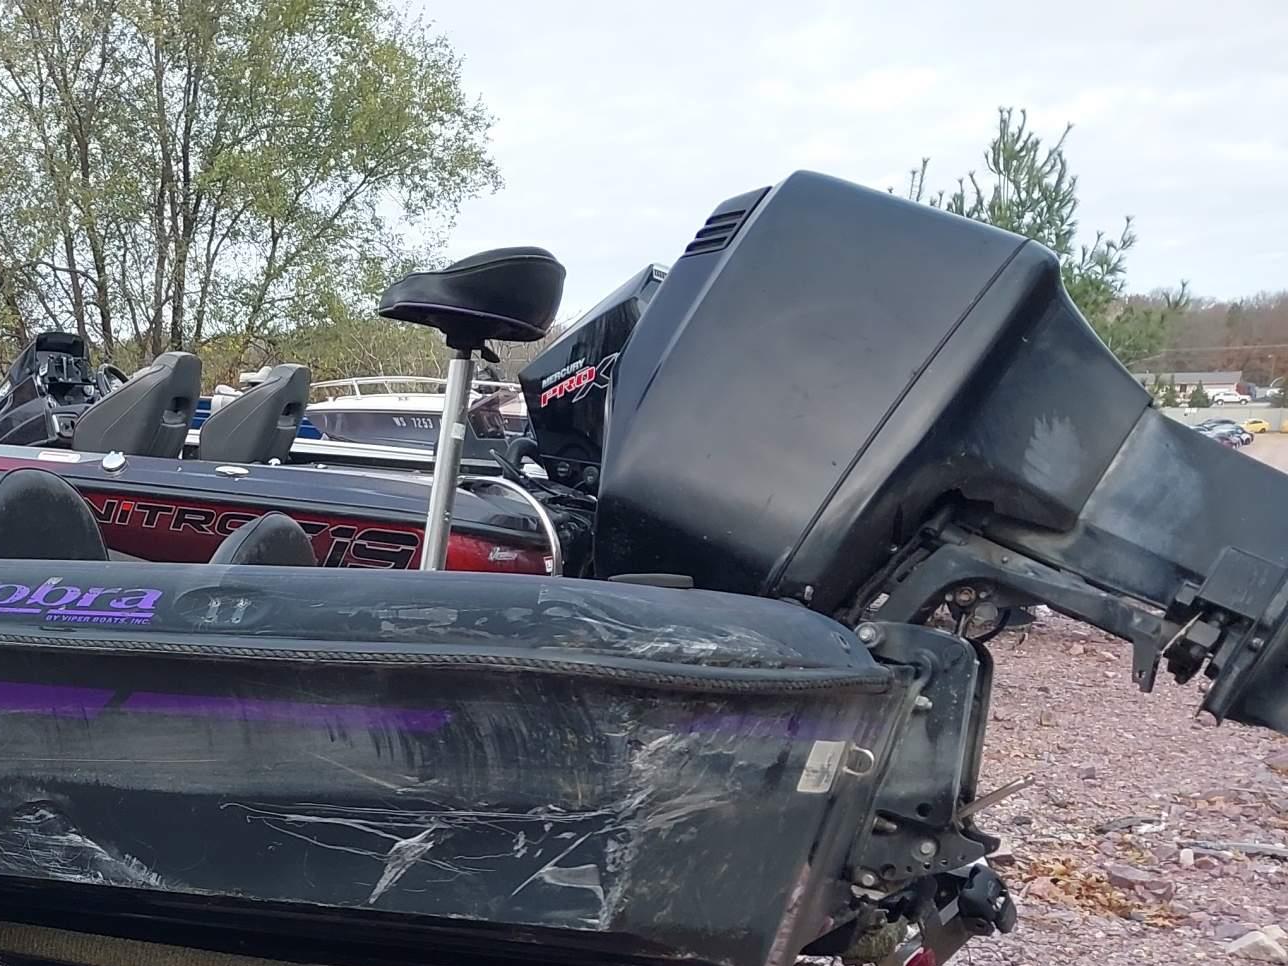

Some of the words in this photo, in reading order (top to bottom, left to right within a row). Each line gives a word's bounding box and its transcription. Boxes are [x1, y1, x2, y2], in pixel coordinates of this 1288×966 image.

[541, 358, 585, 389] MERCURY
[392, 416, 407, 427] WS
[411, 417, 433, 429] 7253
[45, 614, 60, 622] BY
[62, 615, 90, 623] VIPER
[129, 617, 152, 625] INC.
